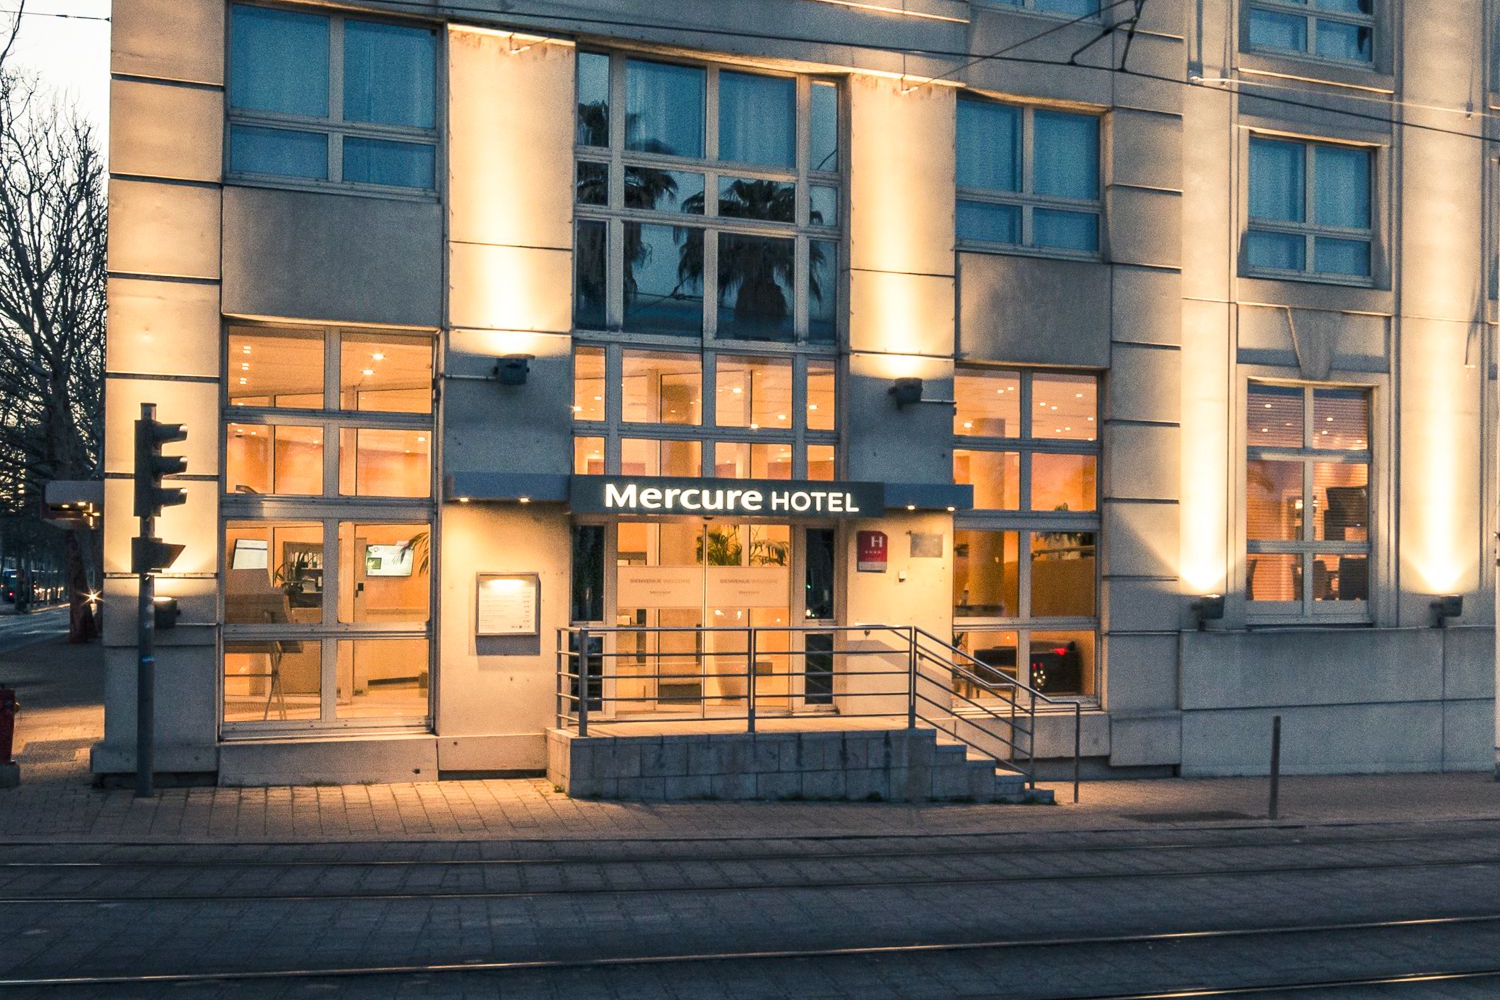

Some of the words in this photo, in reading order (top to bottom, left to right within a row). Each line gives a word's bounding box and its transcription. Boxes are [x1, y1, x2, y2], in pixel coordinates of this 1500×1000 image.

[604, 483, 763, 511] Mercure
[771, 490, 860, 512] HOTEL
[871, 536, 883, 548] H
